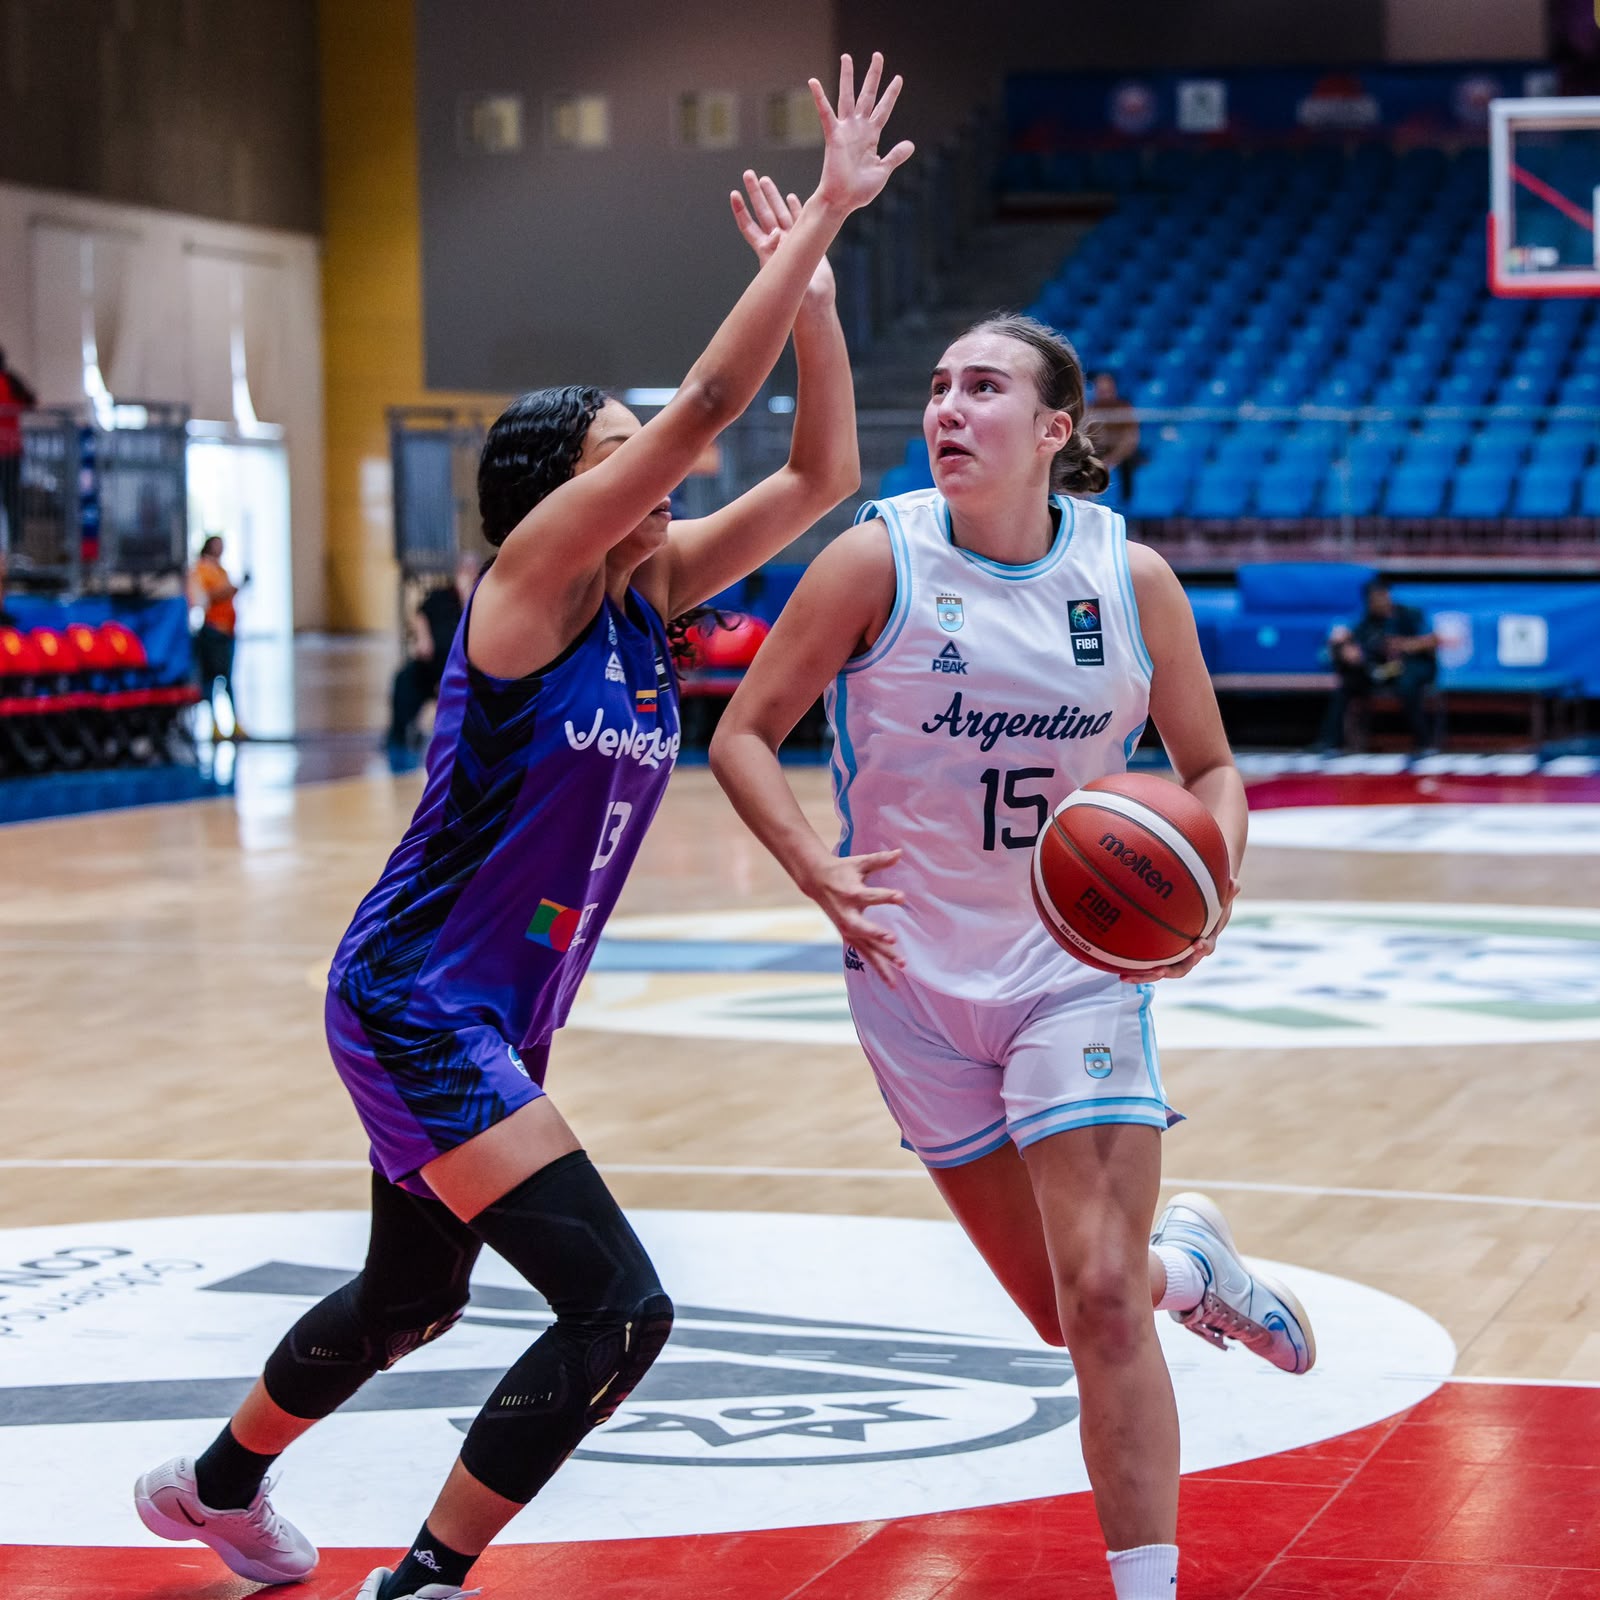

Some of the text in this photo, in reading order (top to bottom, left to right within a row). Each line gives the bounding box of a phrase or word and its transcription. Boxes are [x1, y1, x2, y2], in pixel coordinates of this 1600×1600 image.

[932, 659, 970, 676] PEAK
[1075, 637, 1099, 650] FIBA
[921, 691, 1113, 753] Argentina
[980, 767, 1055, 851] 15
[1098, 832, 1174, 900] molten
[1079, 887, 1122, 925] FIBA
[0, 1246, 134, 1301] CON
